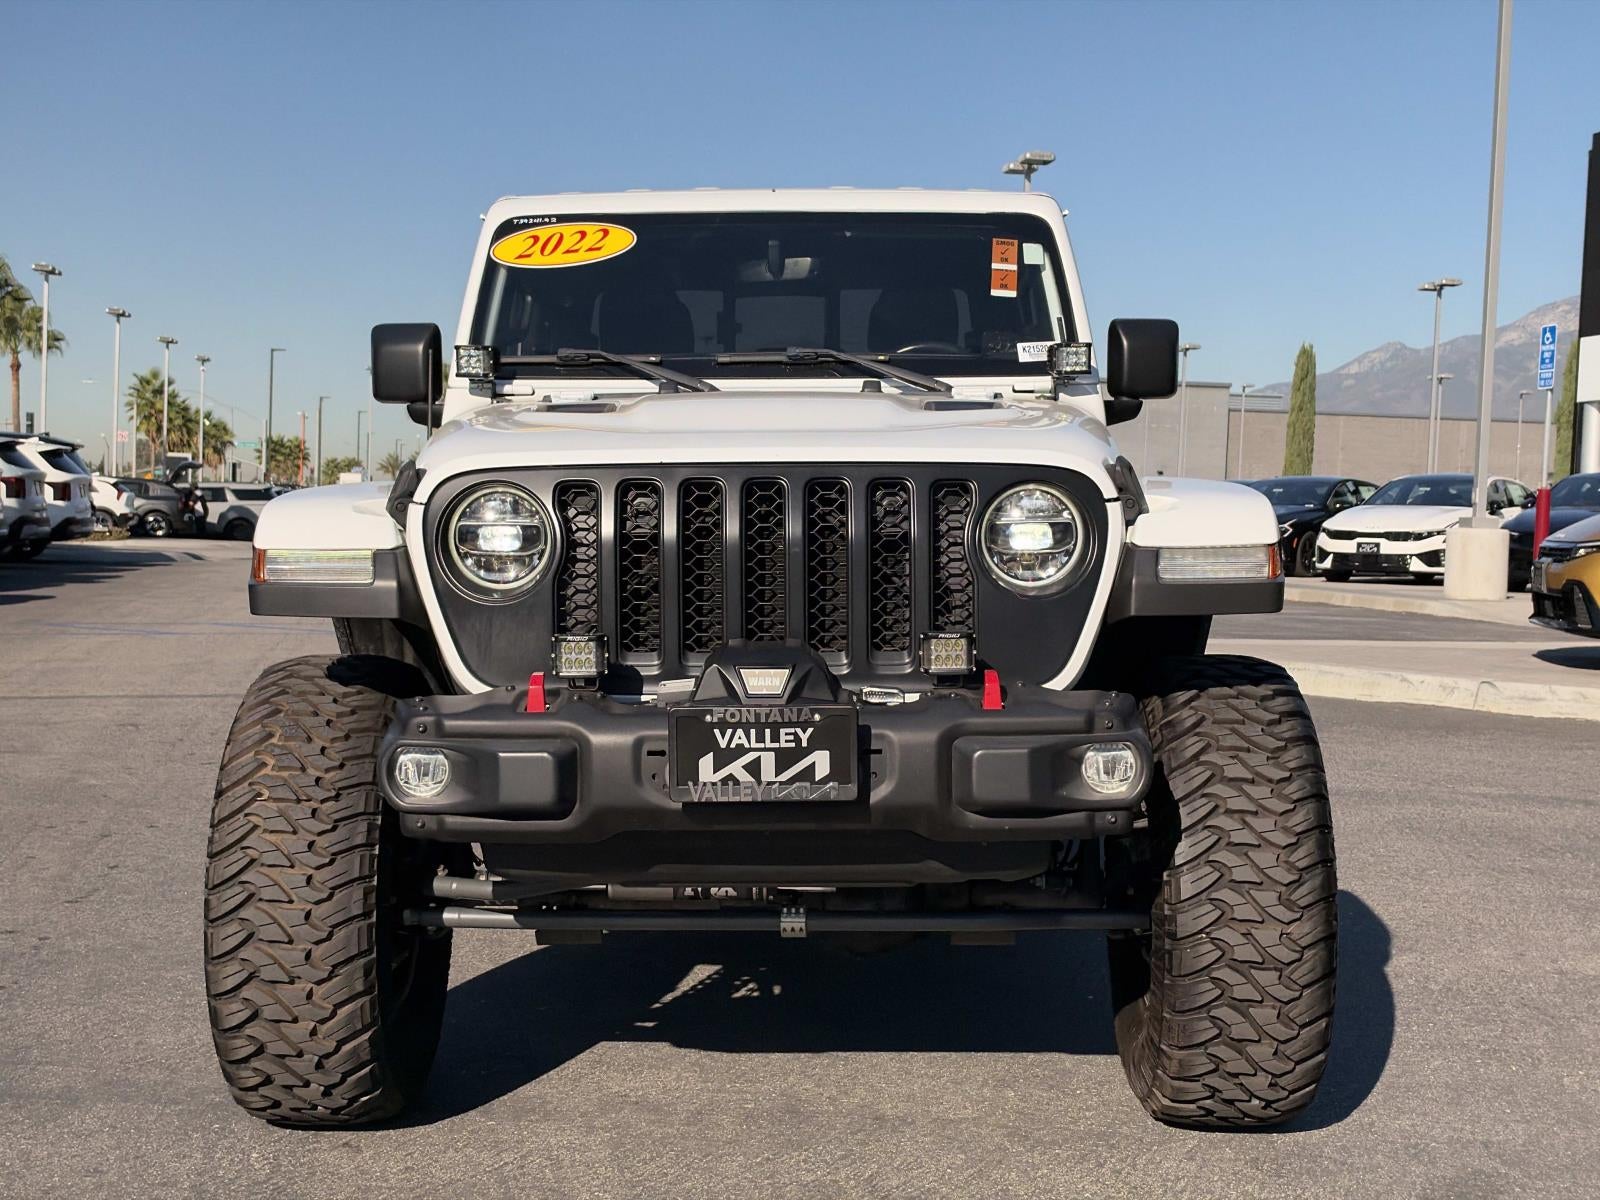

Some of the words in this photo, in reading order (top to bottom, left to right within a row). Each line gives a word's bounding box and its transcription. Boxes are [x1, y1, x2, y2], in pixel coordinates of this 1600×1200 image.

[514, 228, 610, 260] 2022
[748, 676, 780, 687] WARN
[711, 707, 815, 723] FONTANA
[713, 727, 814, 749] VALLEY
[698, 750, 831, 782] KIA
[687, 781, 767, 801] VALLEY
